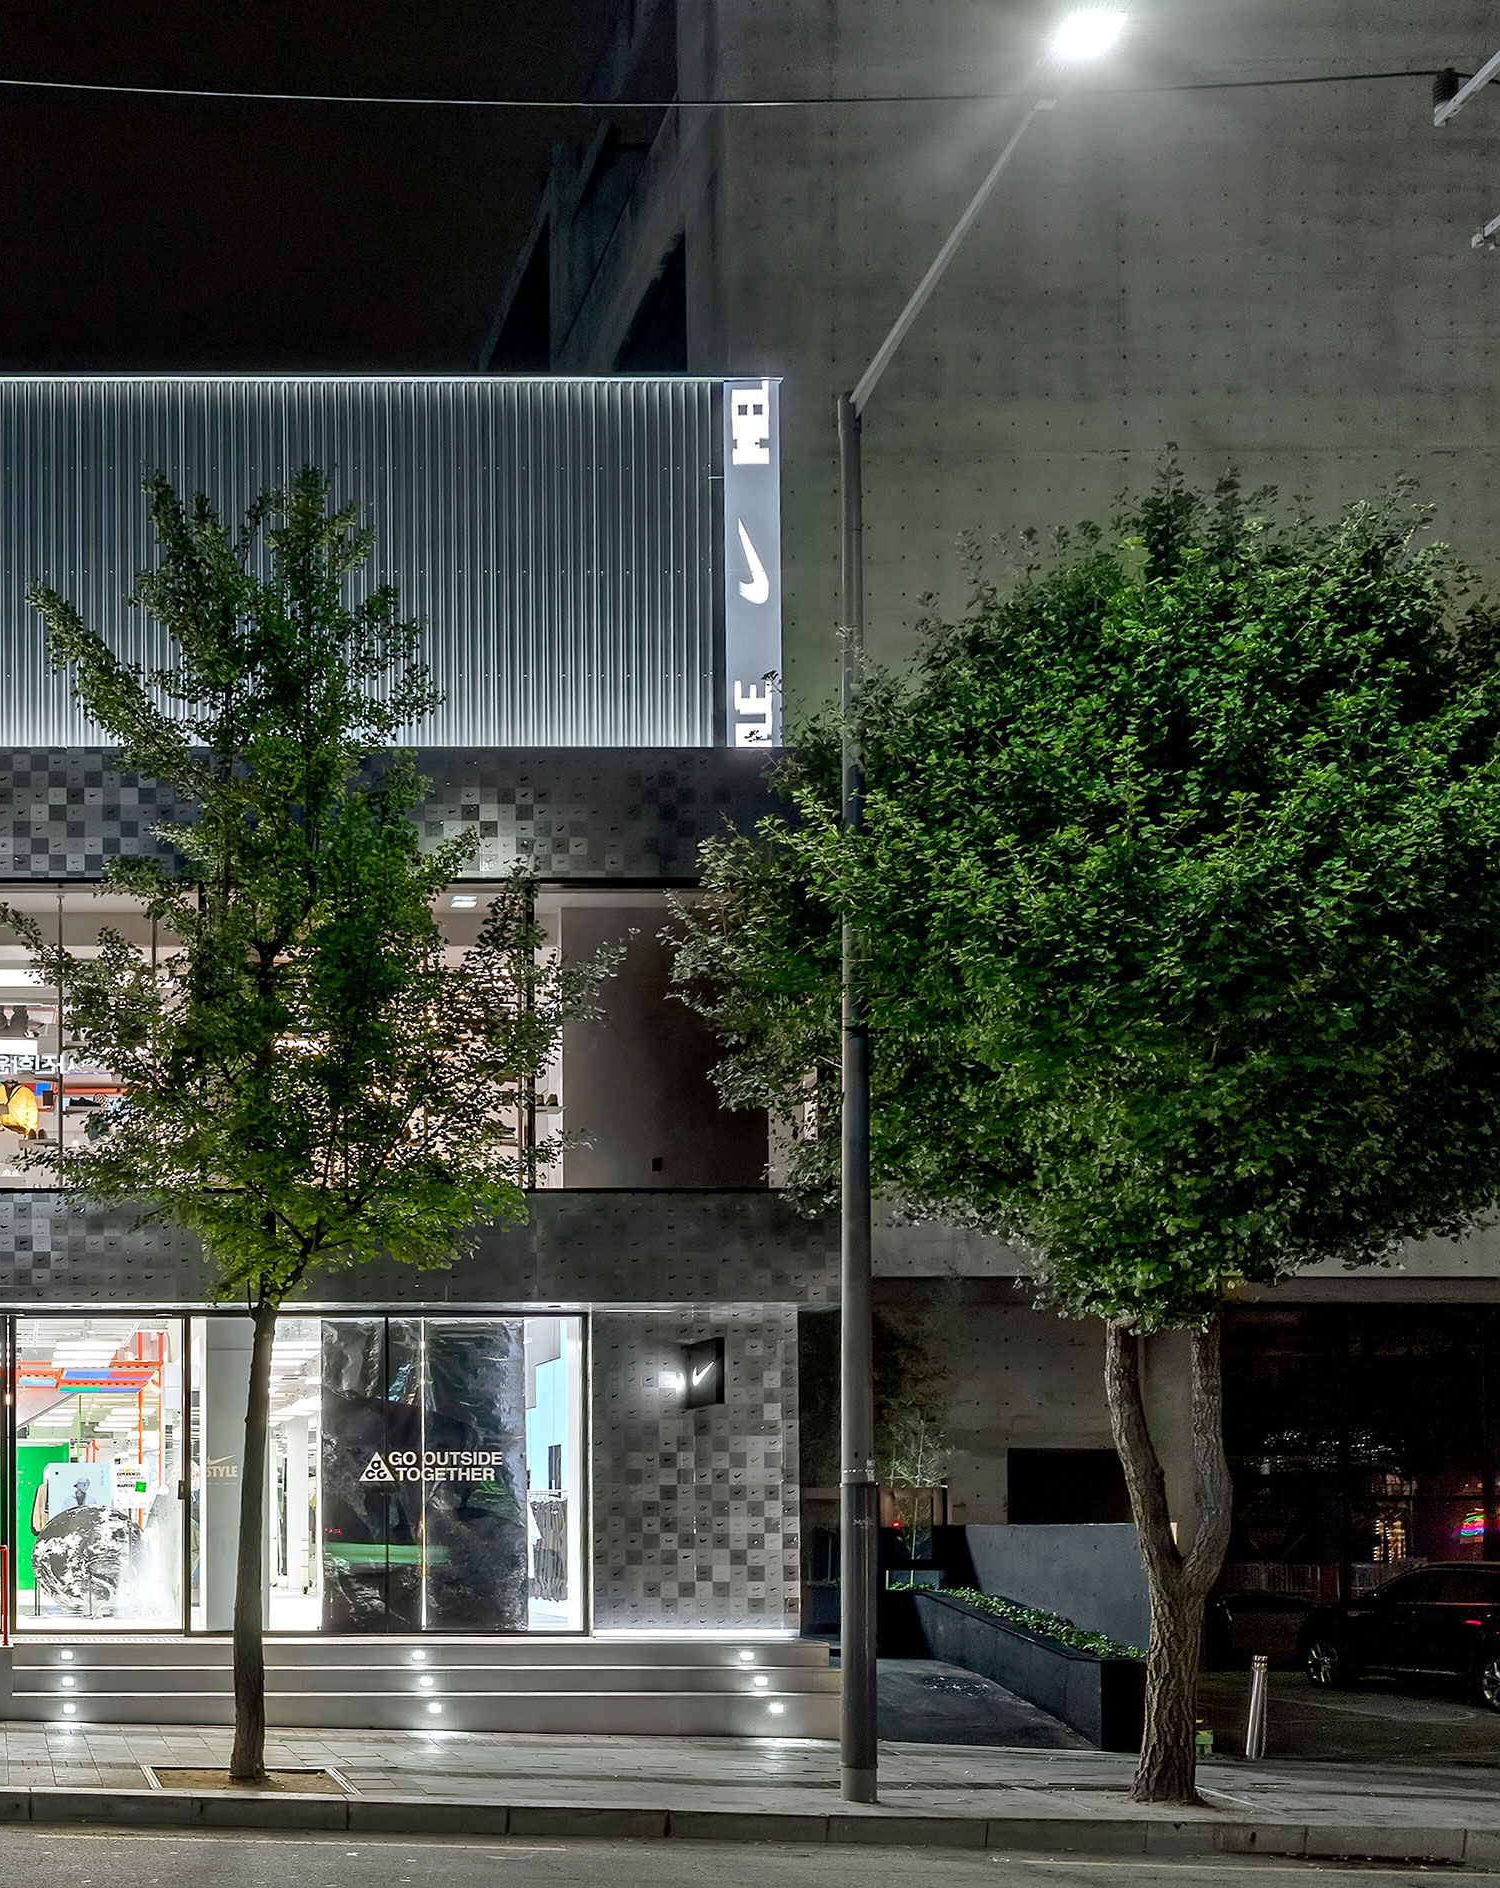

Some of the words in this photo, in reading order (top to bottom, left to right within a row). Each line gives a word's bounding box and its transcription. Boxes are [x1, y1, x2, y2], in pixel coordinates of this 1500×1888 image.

[388, 1451, 417, 1466] GO
[422, 1451, 503, 1466] OUTSIDE
[206, 1465, 238, 1478] STYLE
[395, 1467, 496, 1482] TOGETHER
